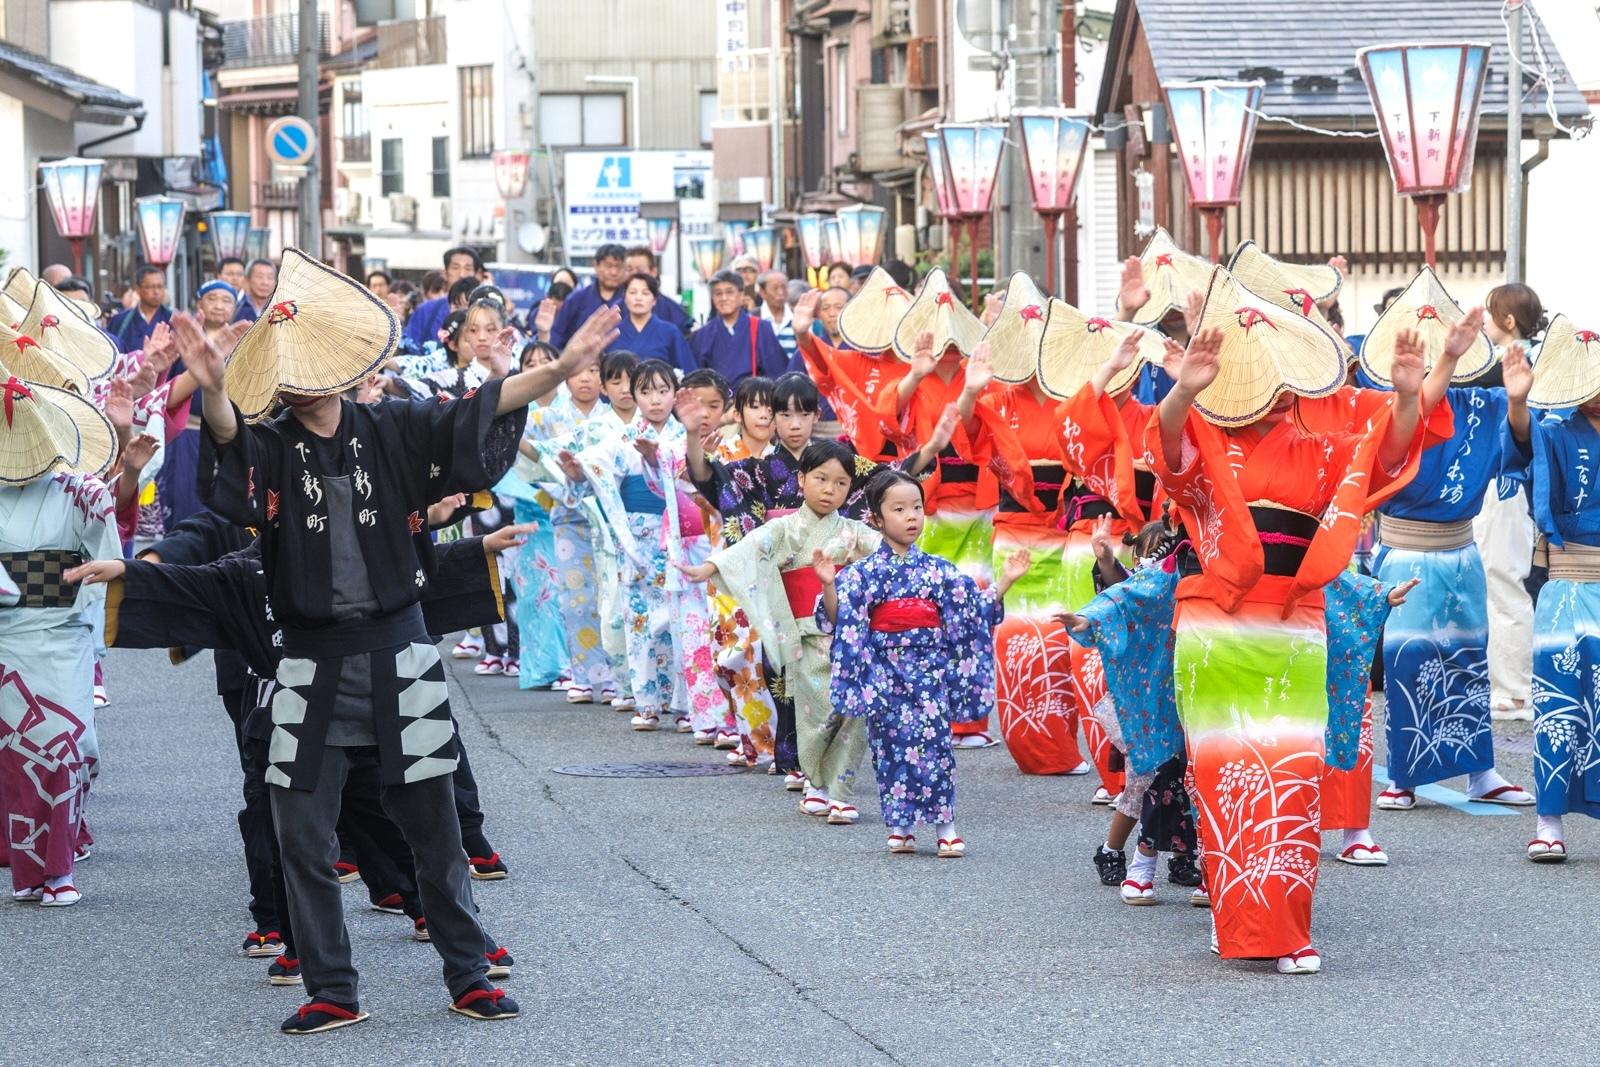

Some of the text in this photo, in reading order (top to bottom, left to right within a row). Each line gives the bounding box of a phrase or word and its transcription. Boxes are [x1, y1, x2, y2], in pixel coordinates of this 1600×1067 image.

[1428, 112, 1441, 162] 下新町
[295, 442, 328, 533] 下新町
[349, 437, 378, 528] 下新町
[1574, 448, 1591, 515] 二百十
